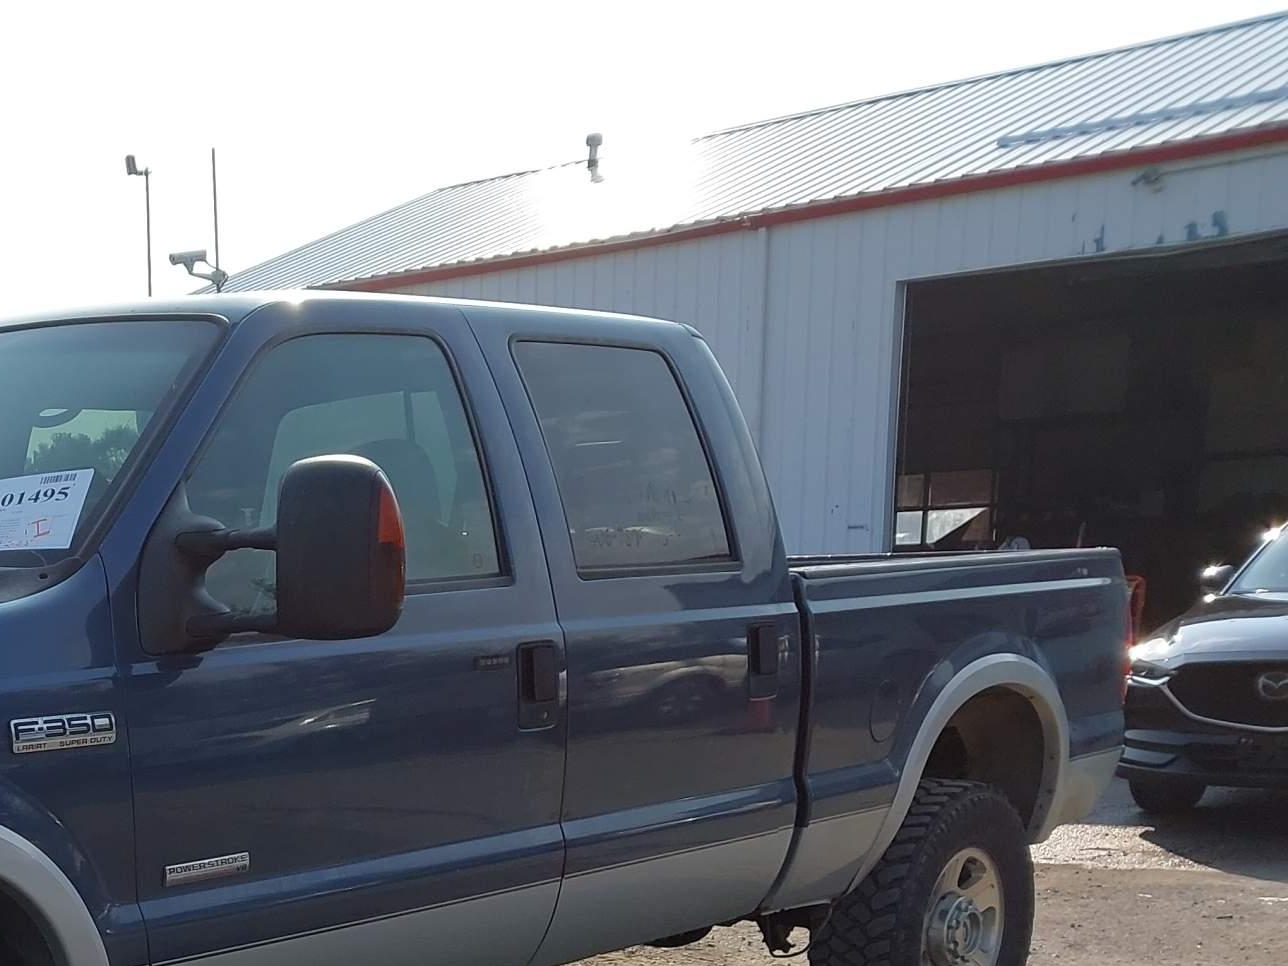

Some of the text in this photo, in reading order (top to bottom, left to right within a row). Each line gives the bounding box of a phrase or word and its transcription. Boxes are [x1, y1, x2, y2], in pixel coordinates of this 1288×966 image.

[14, 713, 114, 741] F-350
[17, 735, 113, 752] LARIAT SUPER DUTY
